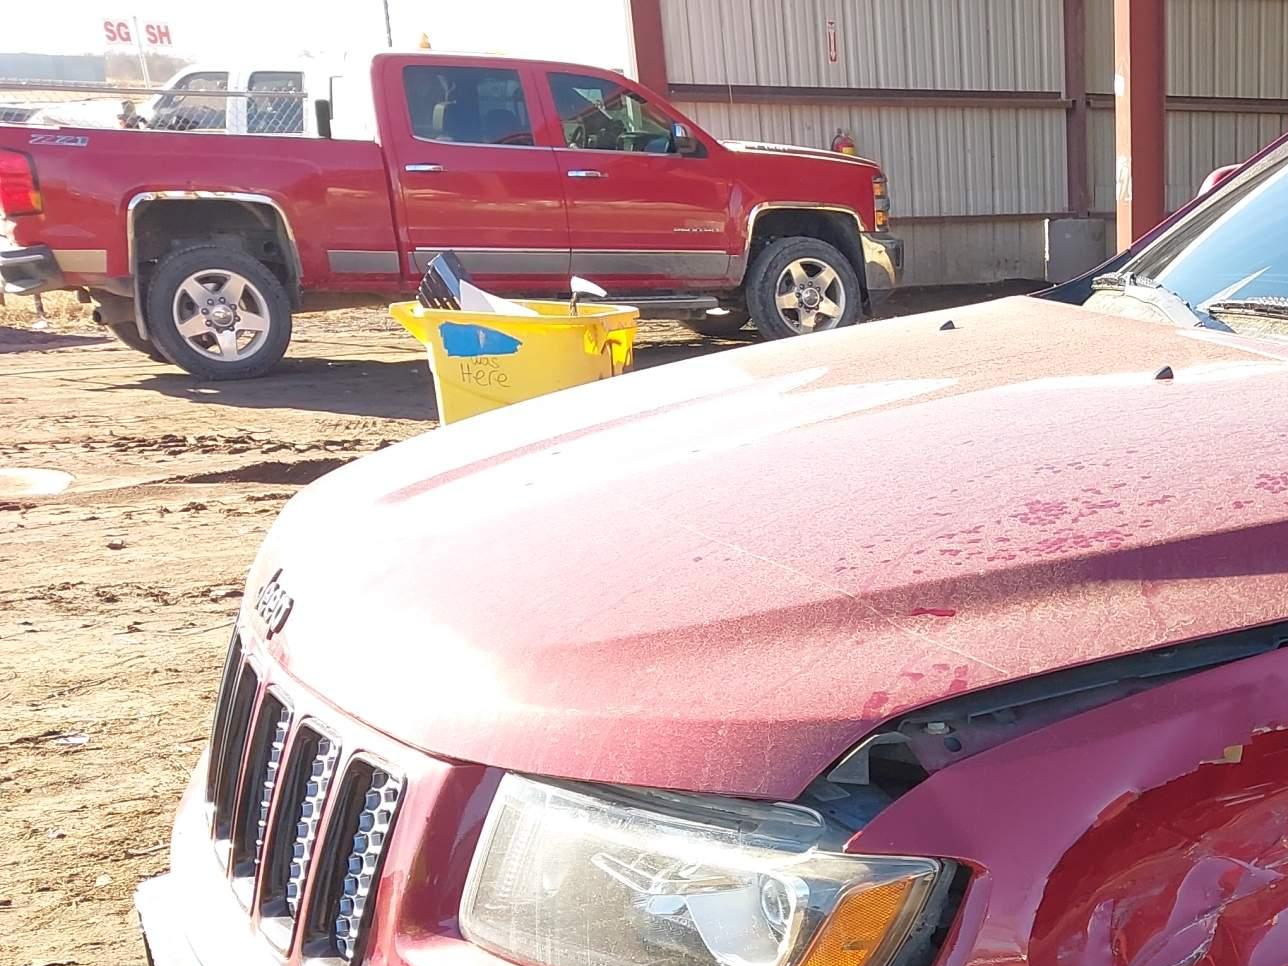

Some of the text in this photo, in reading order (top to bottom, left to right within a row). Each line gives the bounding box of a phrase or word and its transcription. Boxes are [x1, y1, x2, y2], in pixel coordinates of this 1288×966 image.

[103, 20, 173, 45] SG SH
[460, 362, 512, 388] Here
